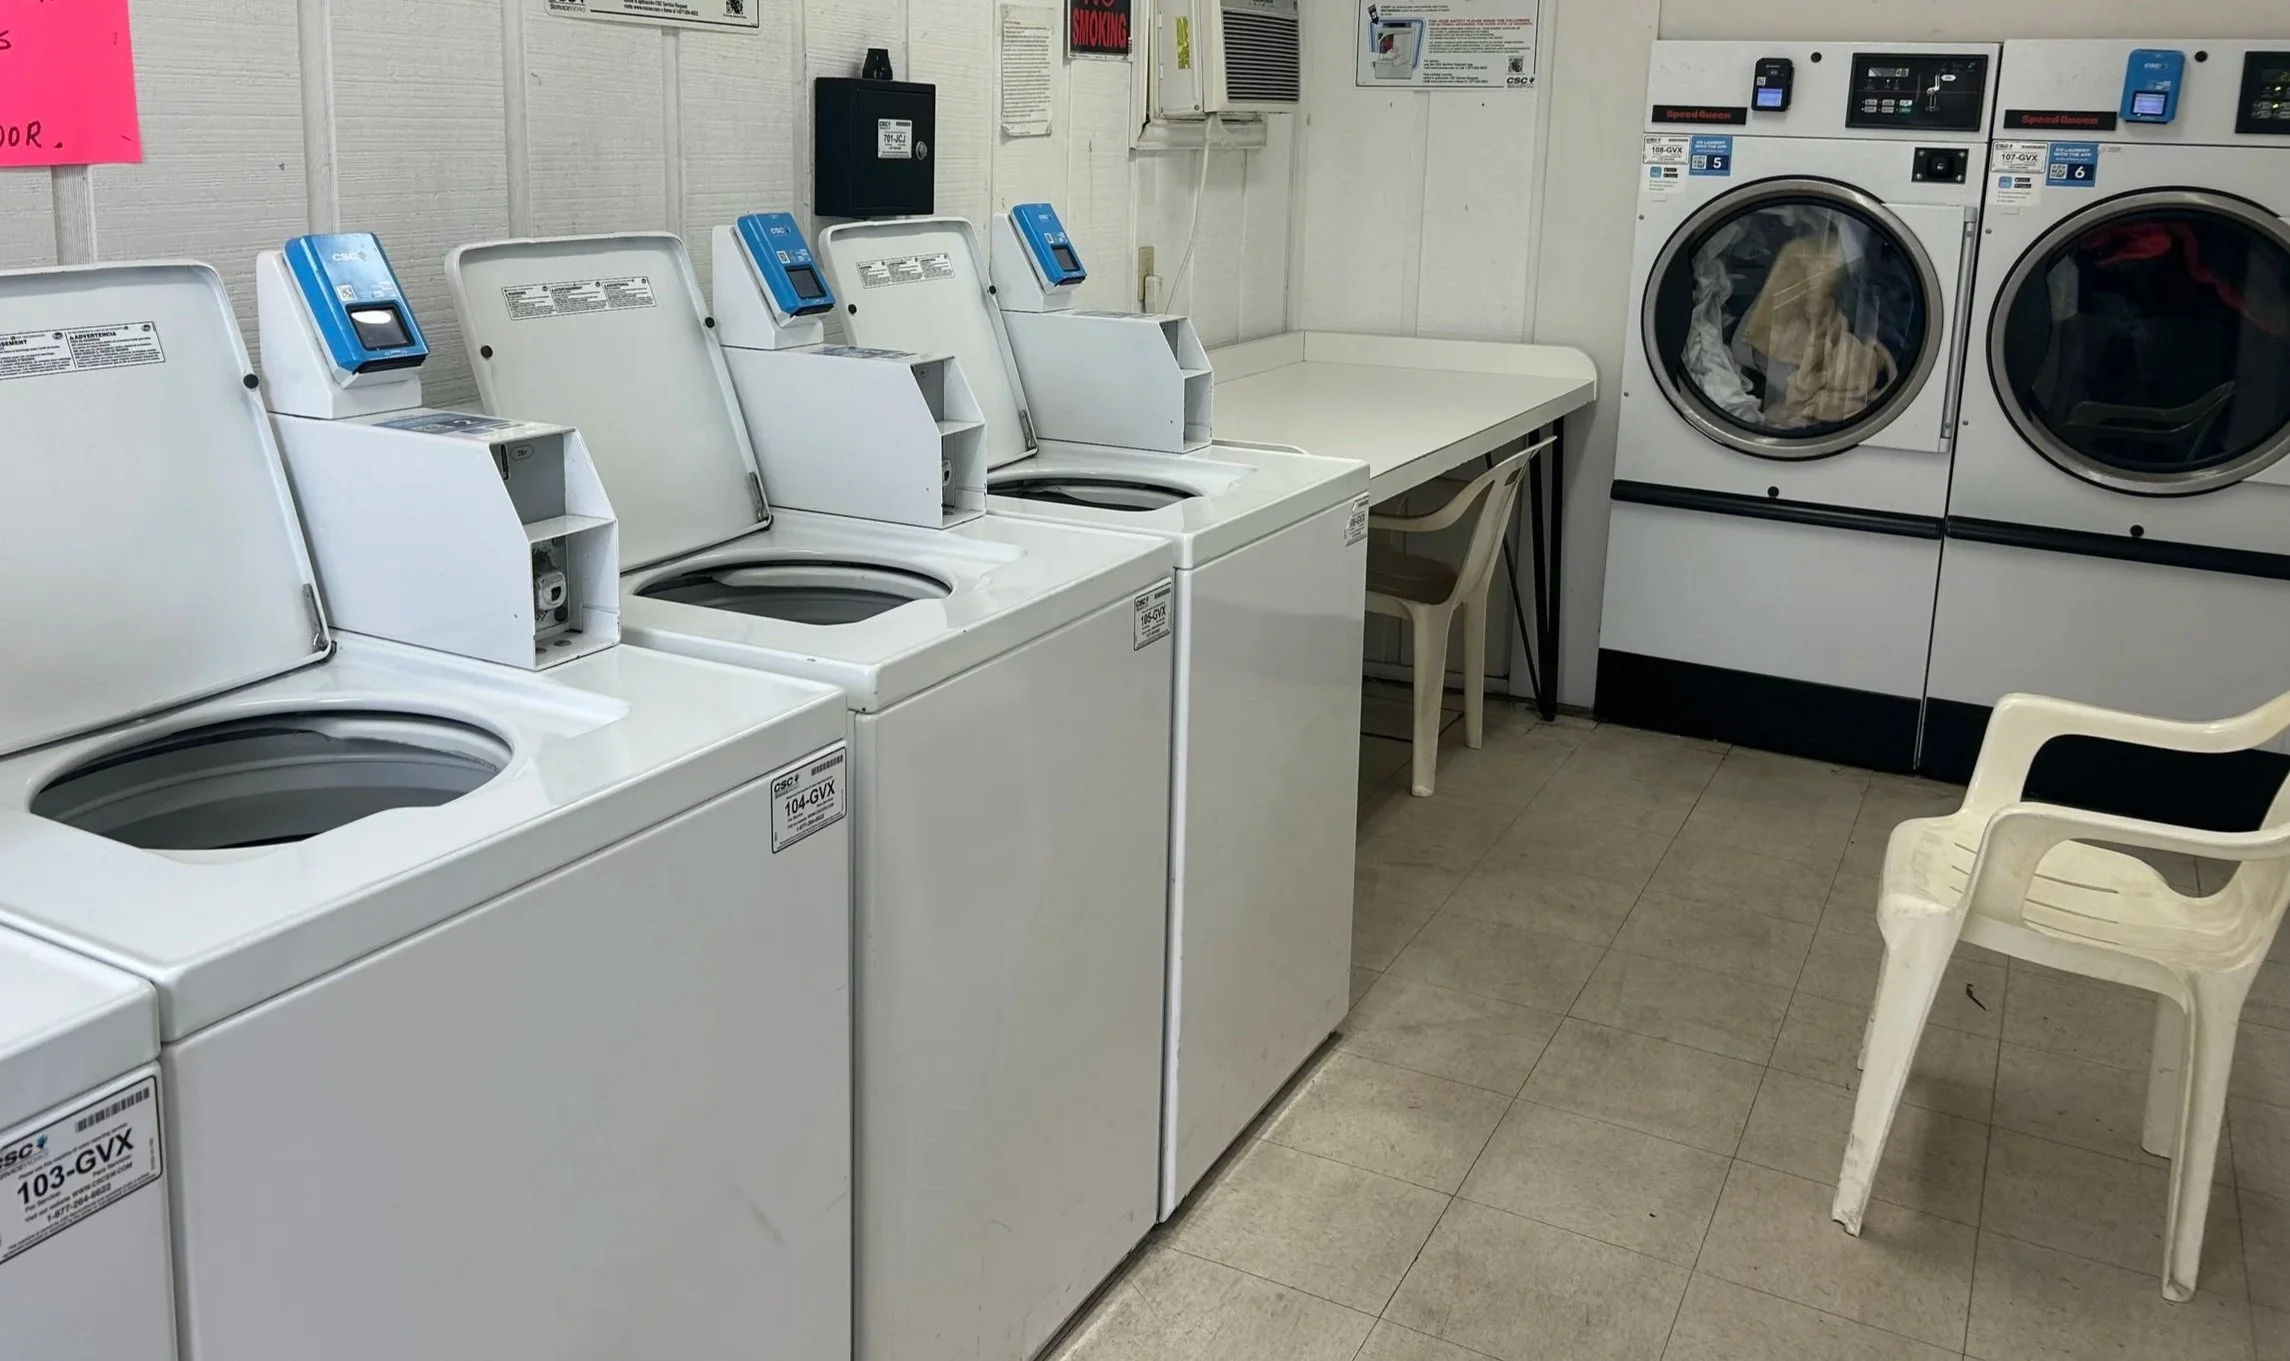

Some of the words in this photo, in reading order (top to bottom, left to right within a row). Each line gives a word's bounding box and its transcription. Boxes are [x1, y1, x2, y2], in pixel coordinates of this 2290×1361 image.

[1072, 8, 1127, 48] SMOKING
[1666, 110, 1698, 119] Speed
[1699, 111, 1731, 119] Queen
[2022, 115, 2059, 124] Speed
[2060, 115, 2098, 124] Queen
[884, 134, 906, 143] 701-JCJ
[1713, 157, 1722, 168] 5
[2074, 166, 2085, 179] 6
[75, 331, 117, 340] ADVERTENCIA
[0, 339, 27, 347] SEMENT
[1141, 603, 1166, 626] 105-GVX
[774, 776, 793, 793] CSC
[785, 779, 835, 817] 104-GVX
[17, 1128, 133, 1204] 103-GVX
